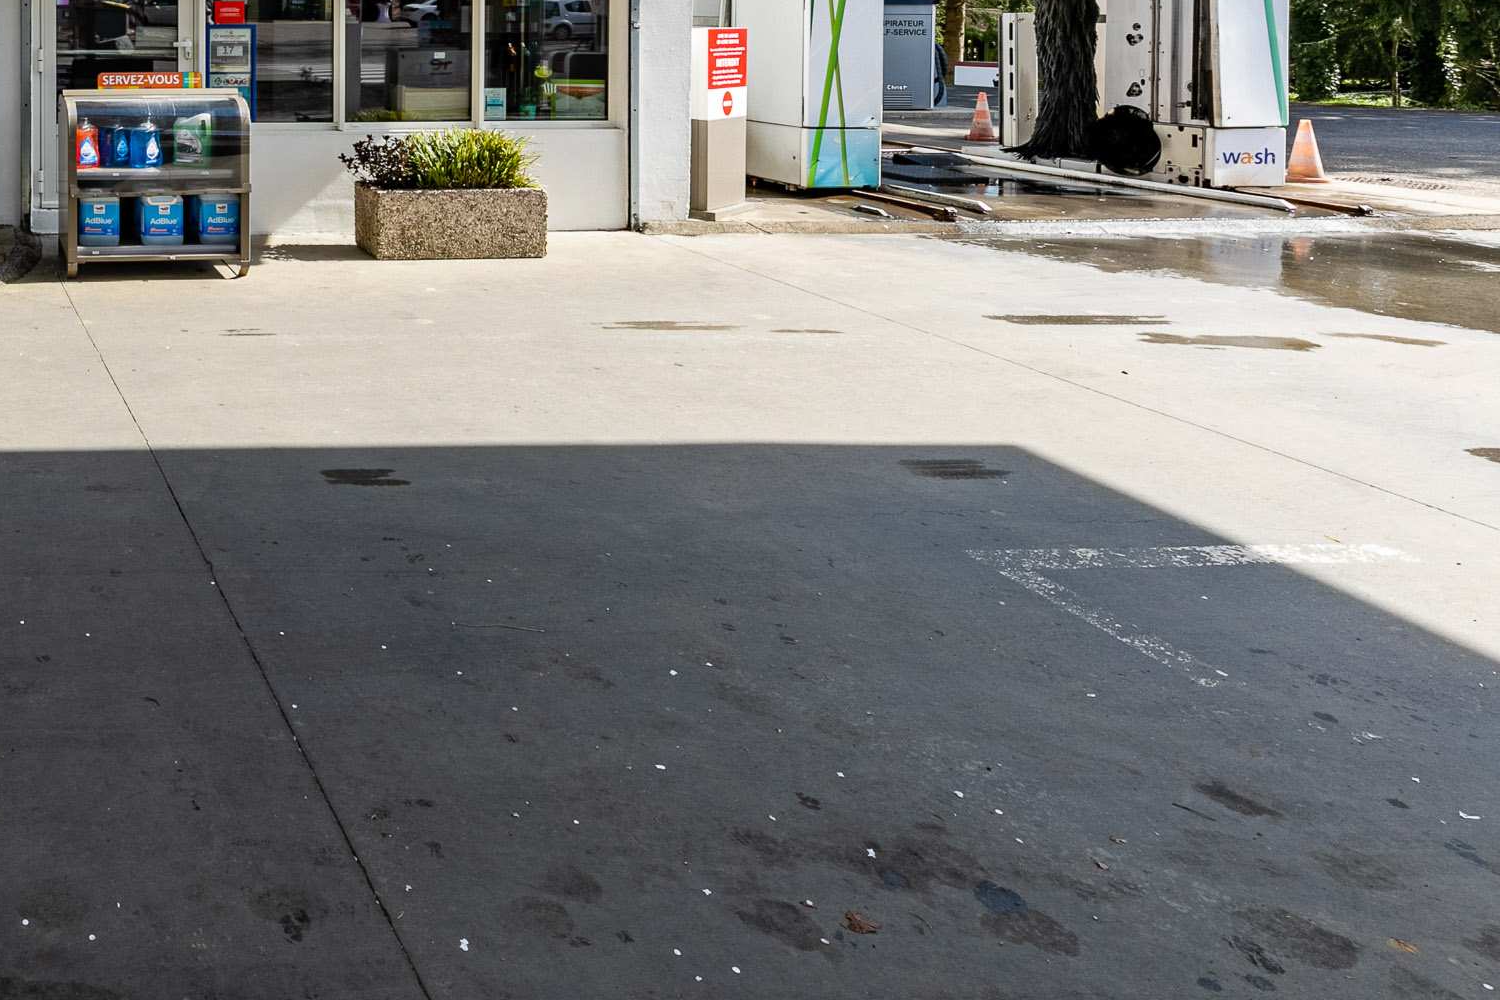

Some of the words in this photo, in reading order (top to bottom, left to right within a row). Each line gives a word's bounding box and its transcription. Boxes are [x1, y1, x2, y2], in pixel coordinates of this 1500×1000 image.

[222, 46, 234, 54] 17
[102, 74, 180, 85] SERVEZ-VOUS
[1222, 148, 1276, 164] wash
[207, 216, 234, 224] AdBlue
